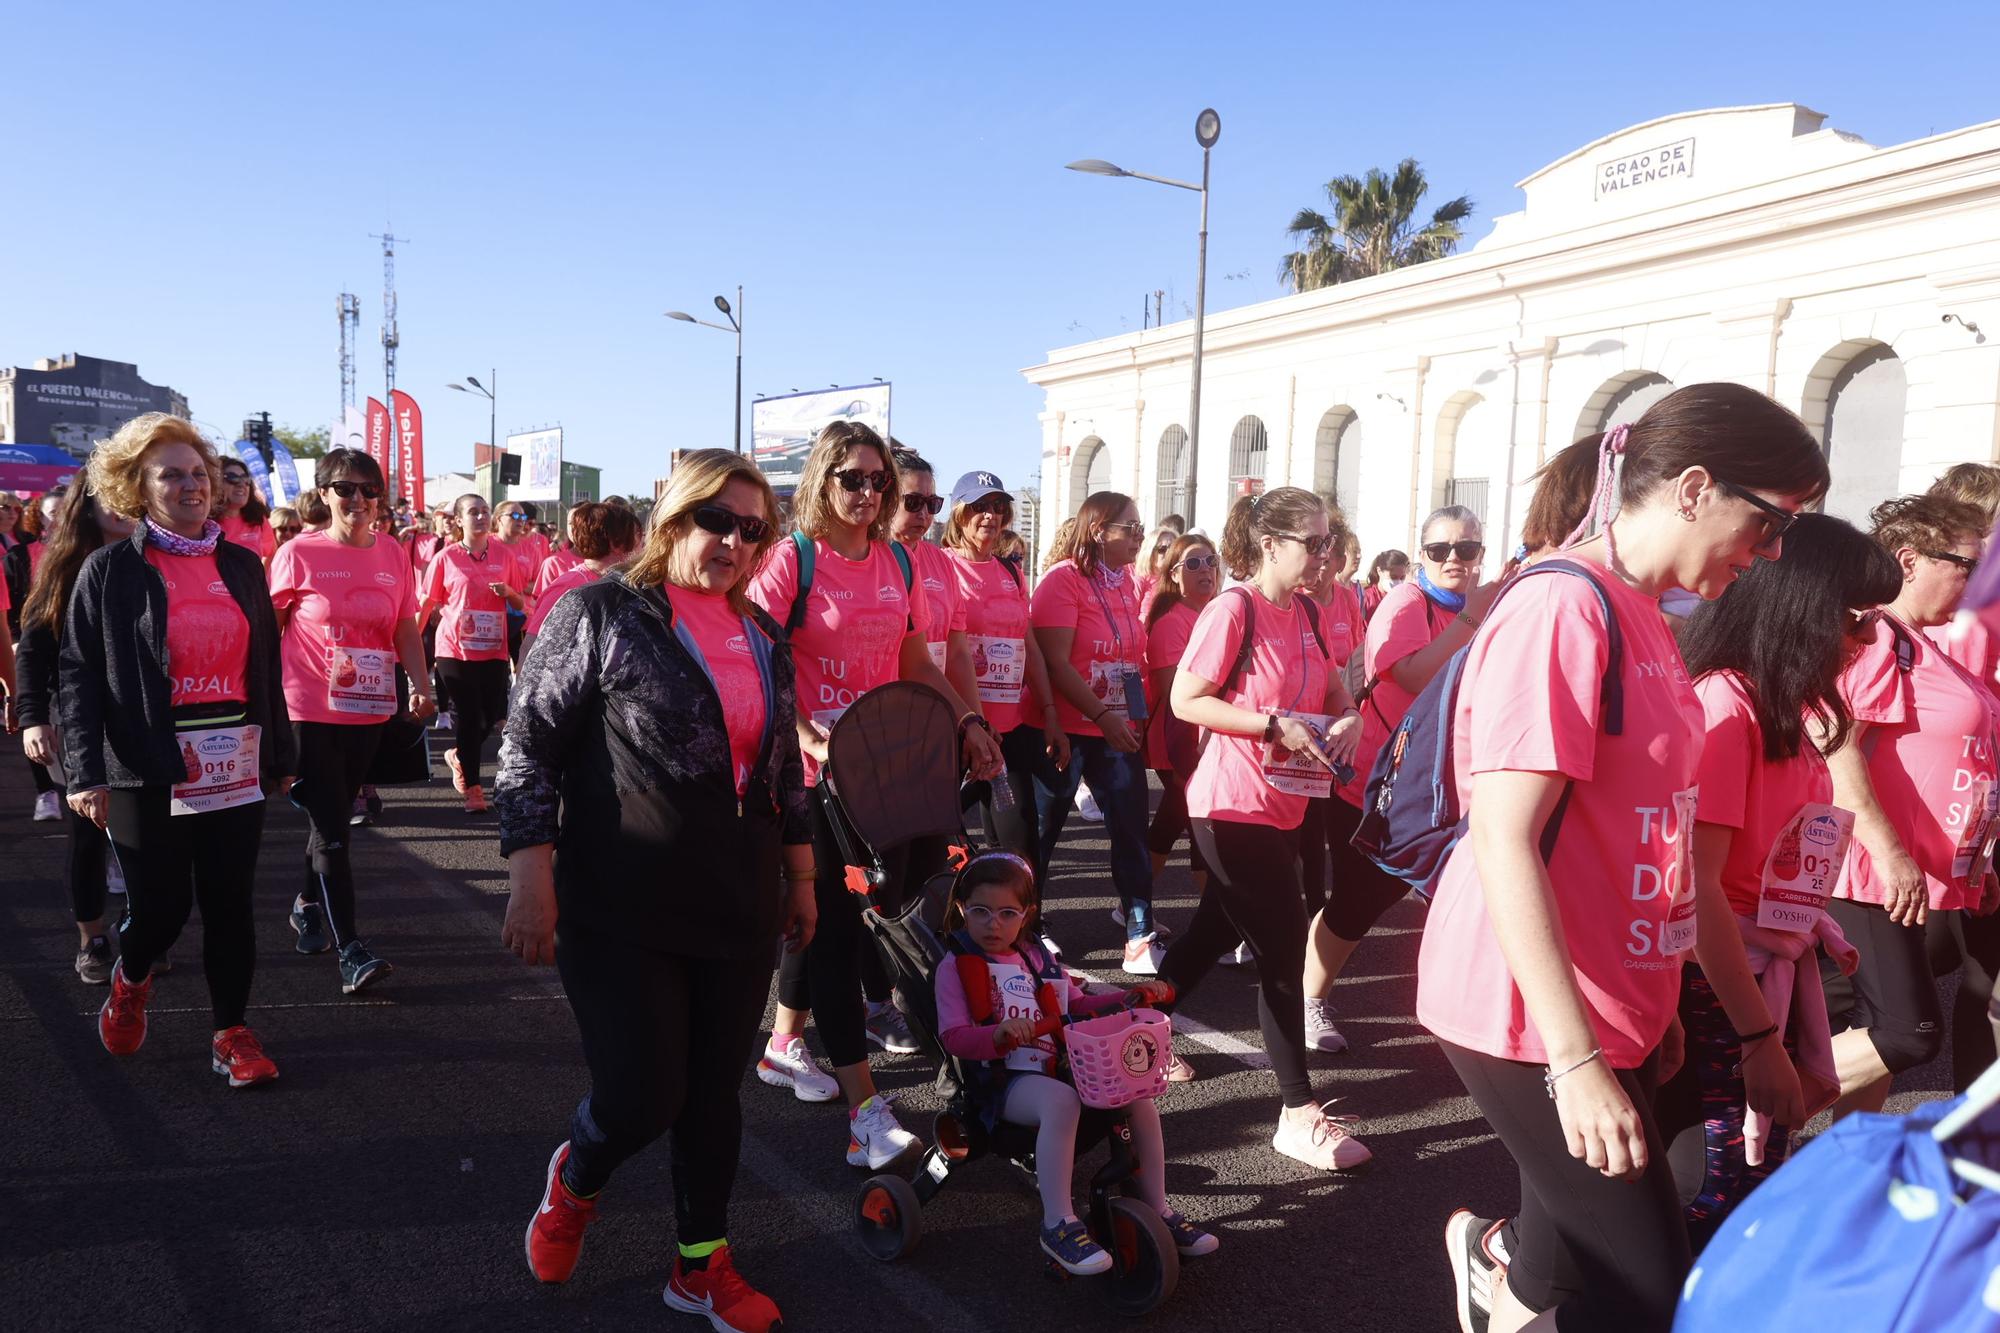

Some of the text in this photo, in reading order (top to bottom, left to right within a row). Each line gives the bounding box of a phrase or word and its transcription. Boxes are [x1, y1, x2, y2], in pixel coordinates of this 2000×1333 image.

[1605, 145, 1685, 178] GRAO DE
[1600, 161, 1686, 194] VALENCIA
[27, 384, 39, 393] EL
[40, 384, 82, 397] PUERTO
[977, 473, 994, 486] NY
[316, 570, 351, 578] OYSHO
[320, 625, 345, 642] TU
[1093, 640, 1114, 656] TU
[818, 656, 845, 680] TU
[990, 663, 1010, 673] 016
[170, 674, 233, 695] ORSAL
[359, 674, 381, 685] 016
[1962, 735, 1988, 760] TU
[205, 759, 236, 774] 016
[1295, 759, 1312, 768] 4545
[211, 775, 230, 784] 5092
[184, 787, 210, 796] CARRERA
[182, 800, 211, 809] OYSHO
[1634, 806, 1679, 845] TU
[1779, 892, 1811, 904] CARRERA
[1773, 909, 1812, 923] OYSHO
[1008, 1005, 1041, 1022] 016
